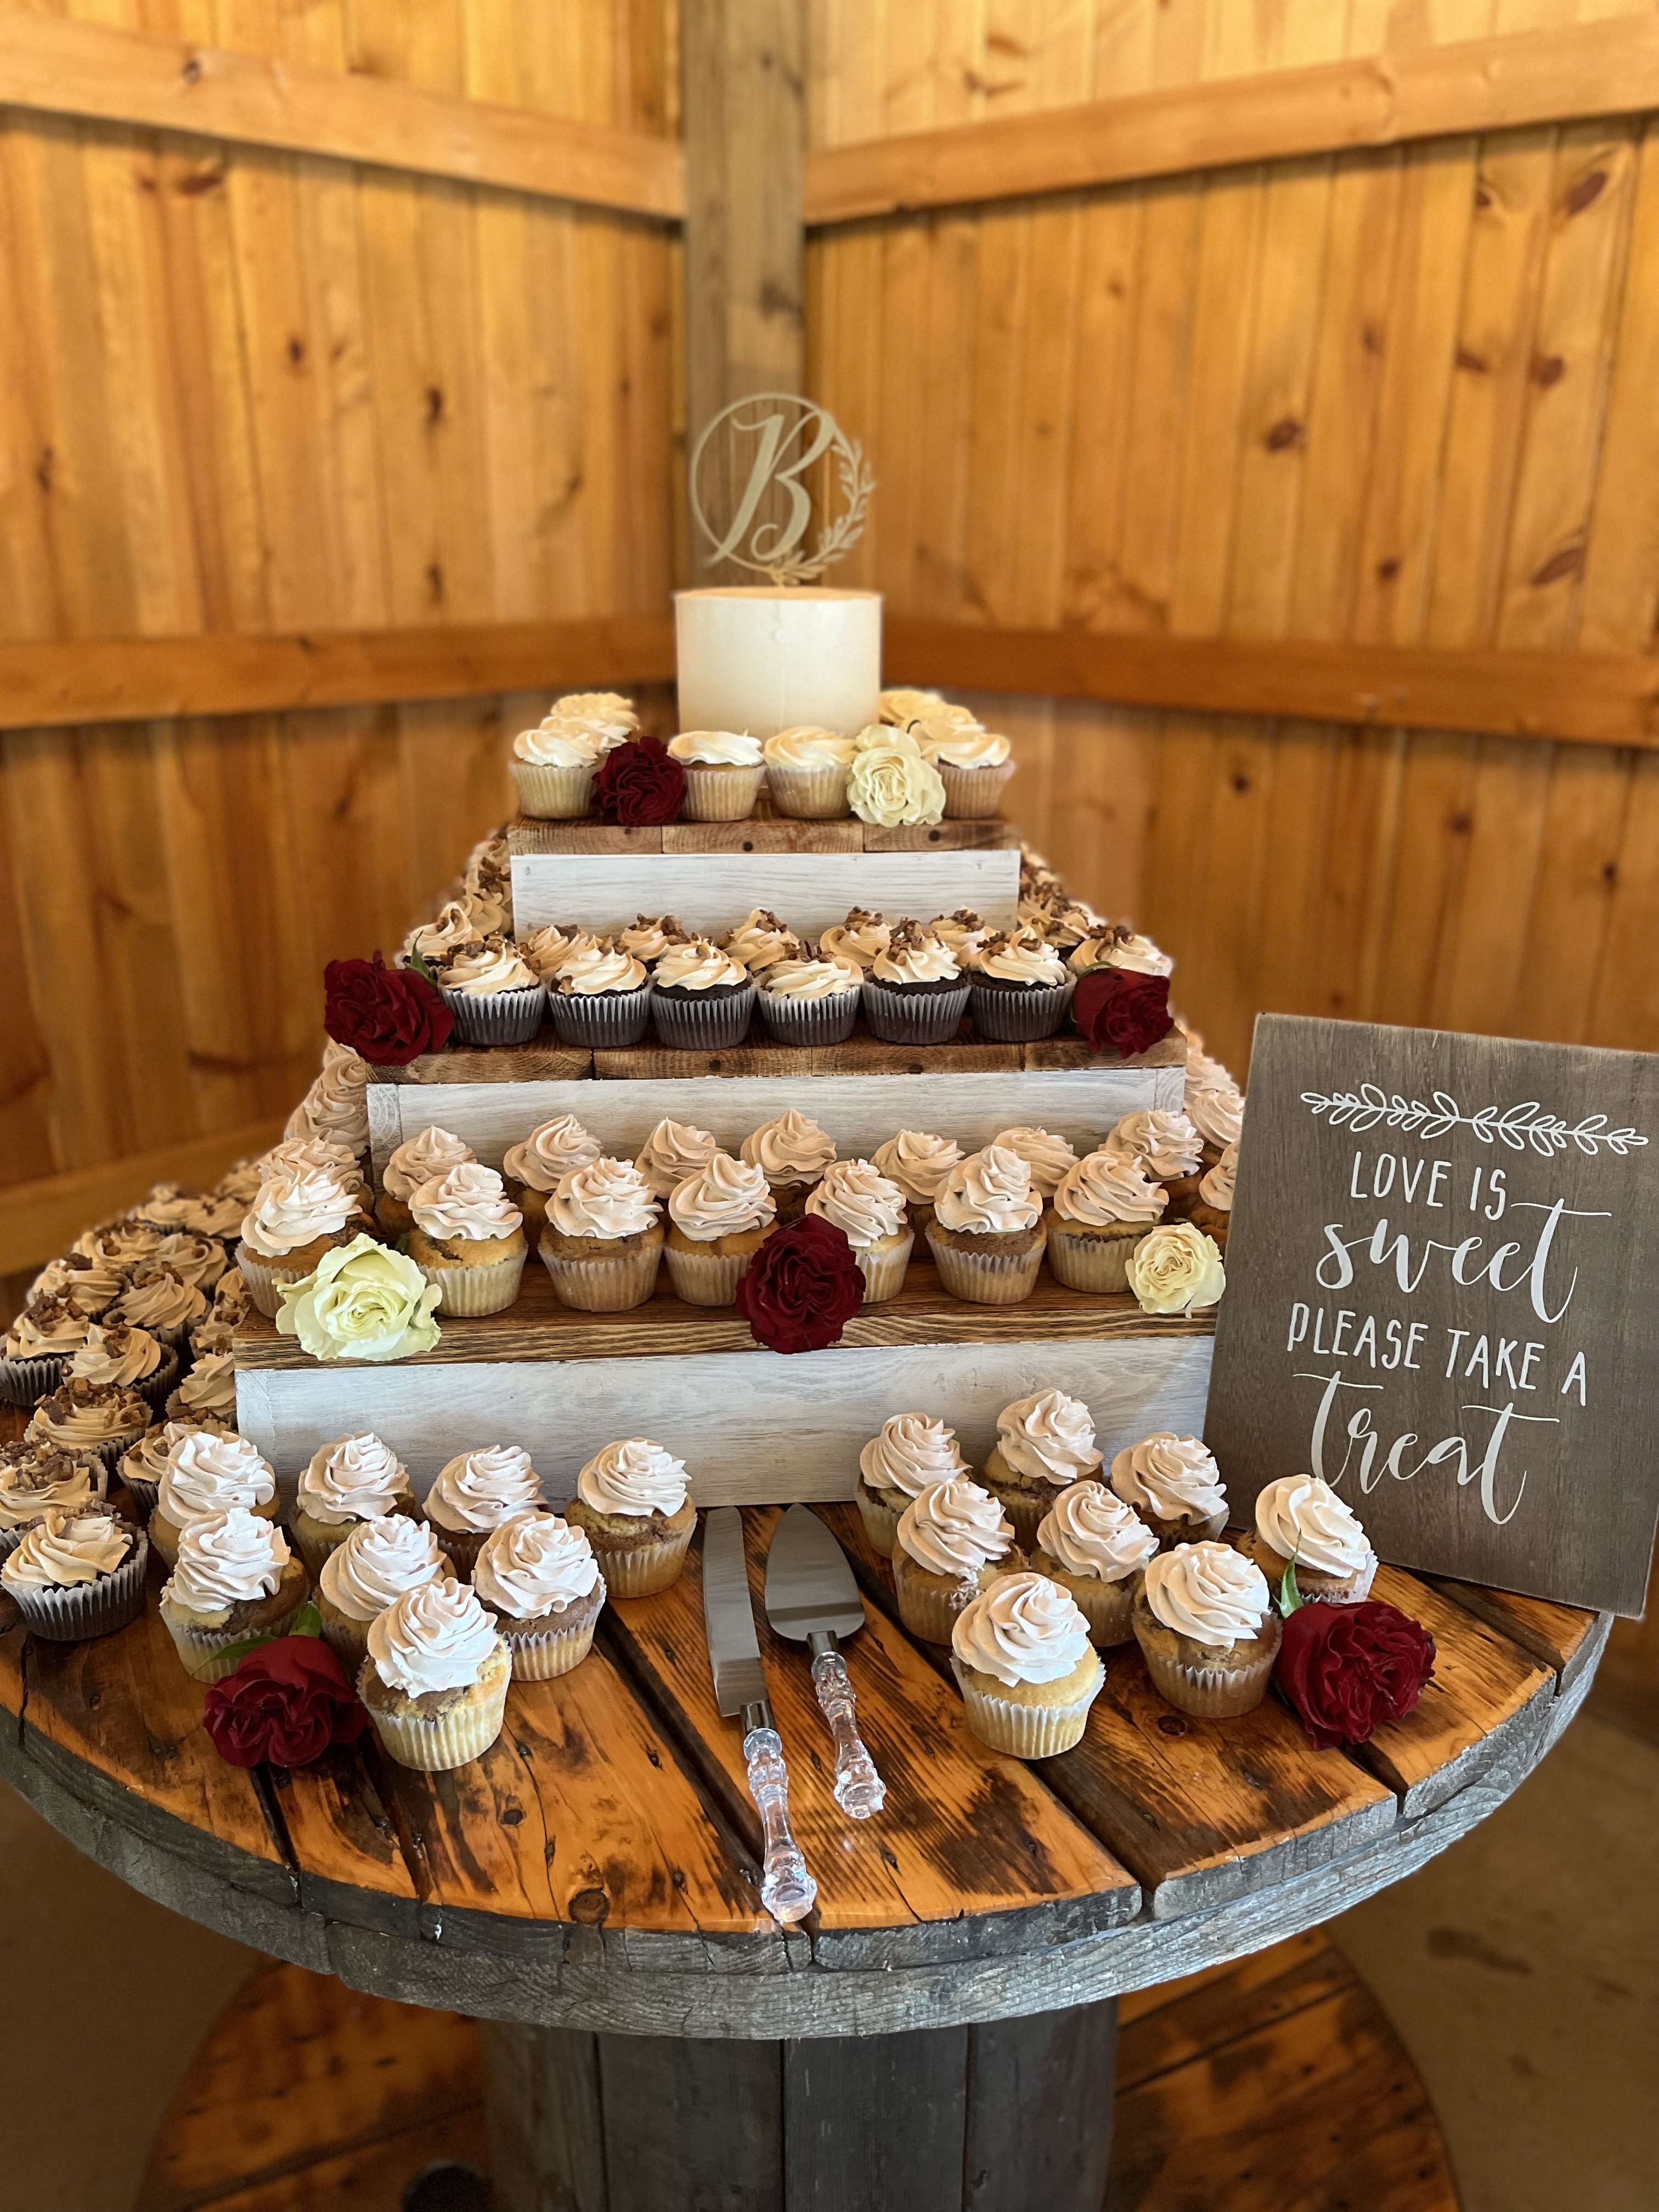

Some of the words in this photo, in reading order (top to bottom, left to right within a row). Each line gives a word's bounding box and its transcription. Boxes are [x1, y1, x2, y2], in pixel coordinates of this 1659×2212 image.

[706, 410, 837, 567] B
[1350, 1151, 1451, 1206] LOVE
[1471, 1166, 1506, 1220] IS
[1316, 1198, 1612, 1323] sweet
[1288, 1303, 1428, 1369] PLEASE
[1447, 1329, 1544, 1390] TAKE
[1561, 1351, 1587, 1406] A
[1292, 1370, 1560, 1525] treat
